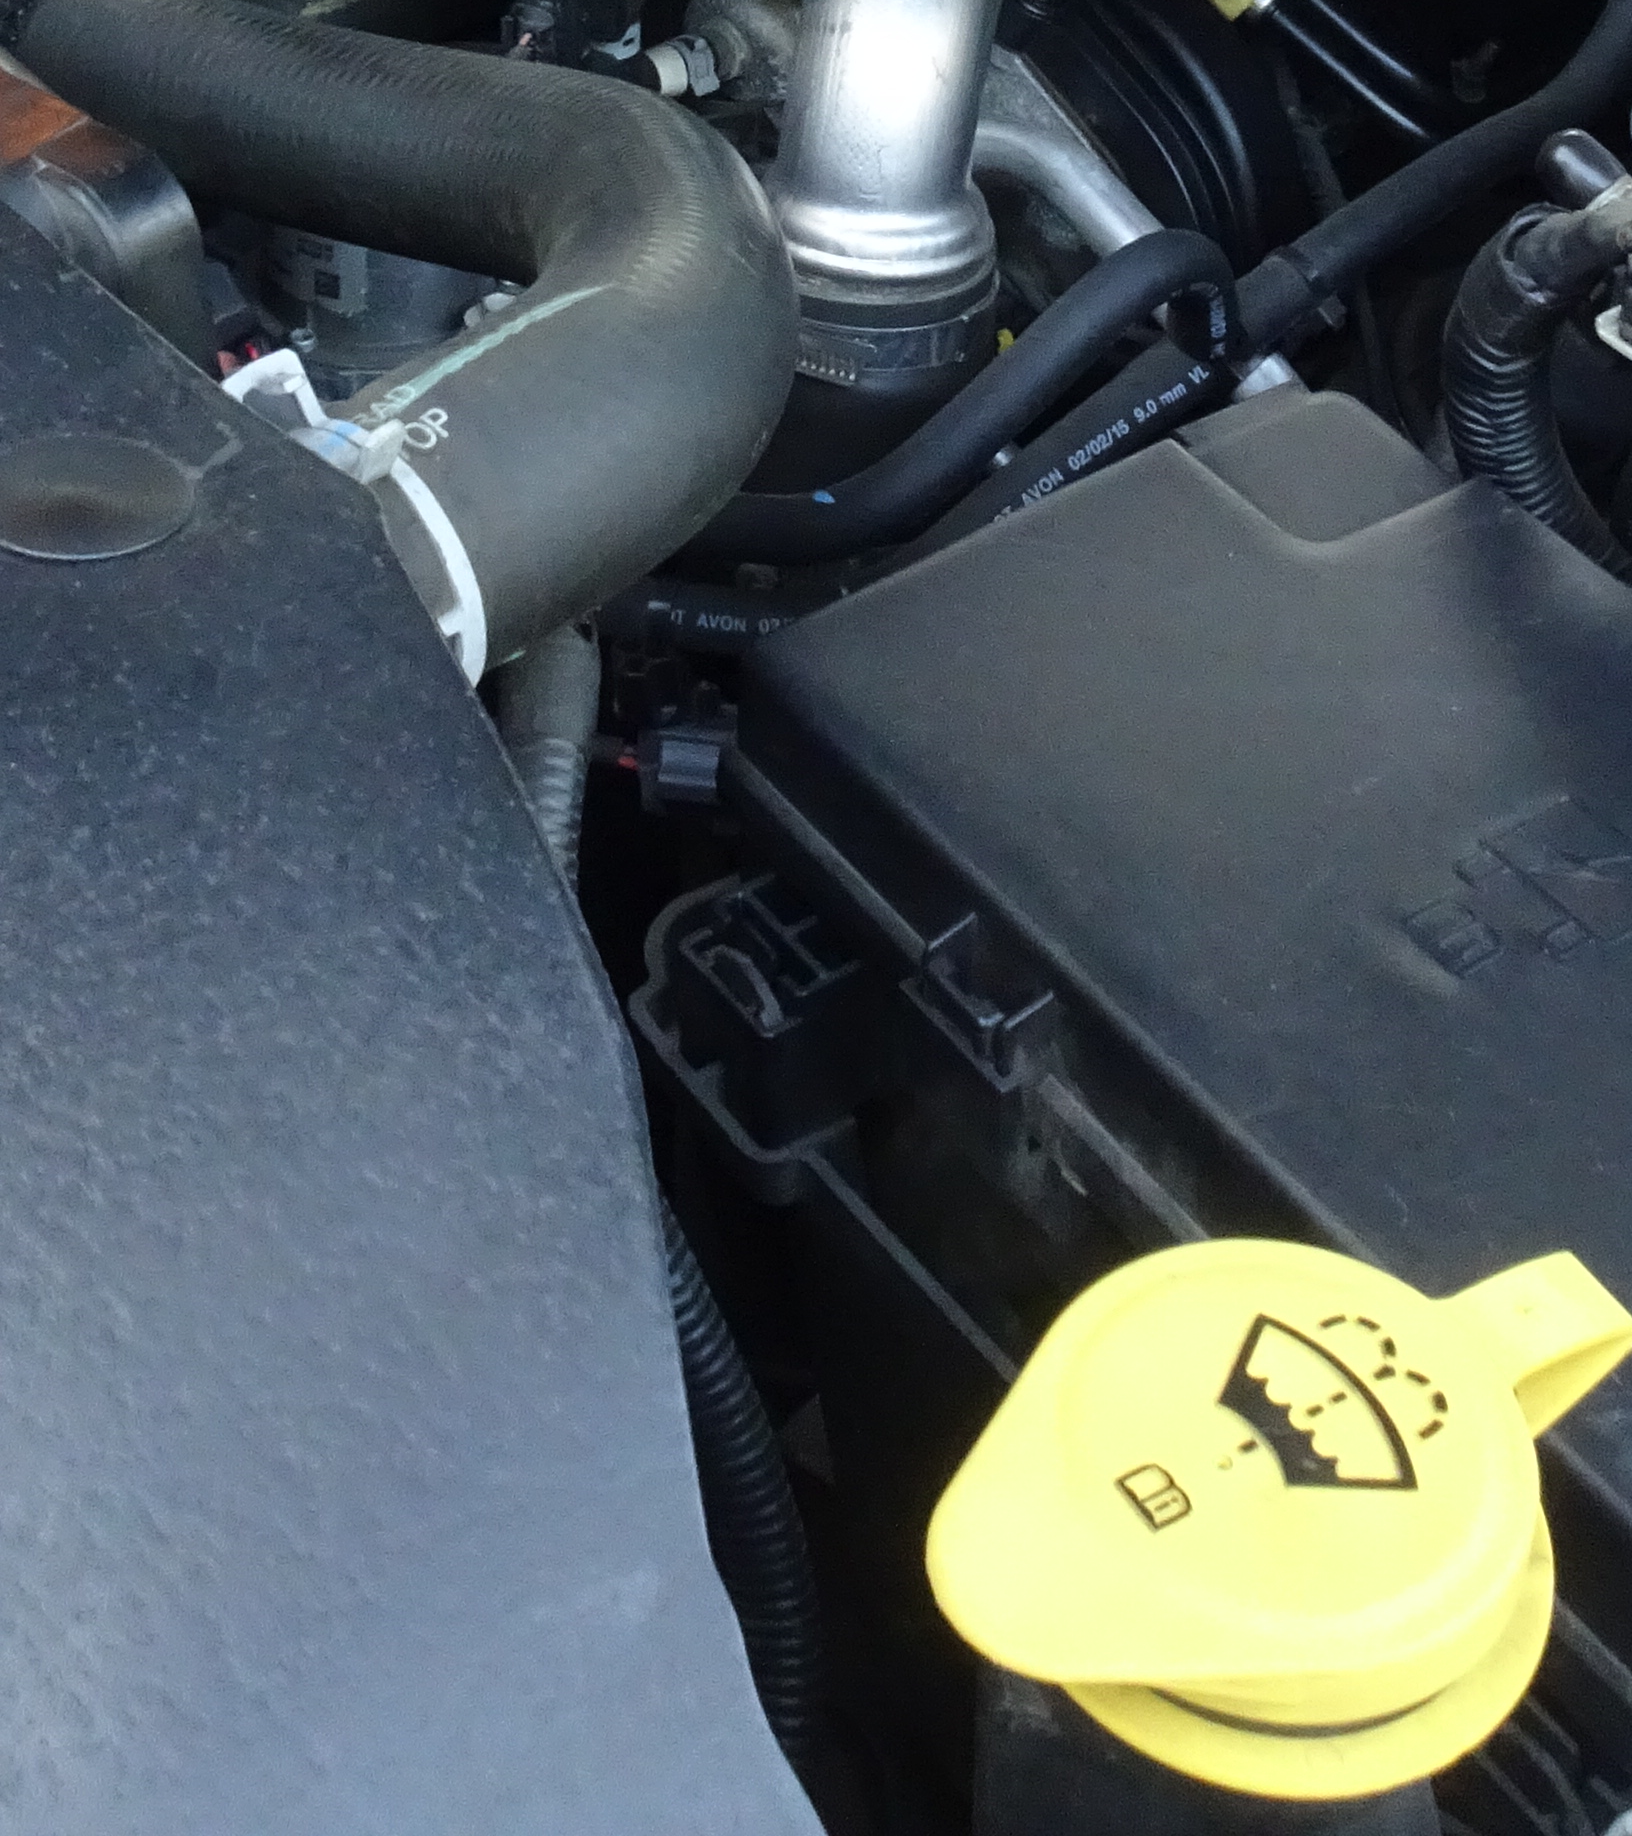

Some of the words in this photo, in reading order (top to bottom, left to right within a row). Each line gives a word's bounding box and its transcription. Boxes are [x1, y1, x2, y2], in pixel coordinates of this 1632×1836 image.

[1020, 467, 1065, 507] AVON
[1067, 419, 1131, 472] 02/02/15
[1133, 399, 1158, 424] 9.0
[1159, 382, 1187, 406] mm
[696, 612, 747, 633] AVON
